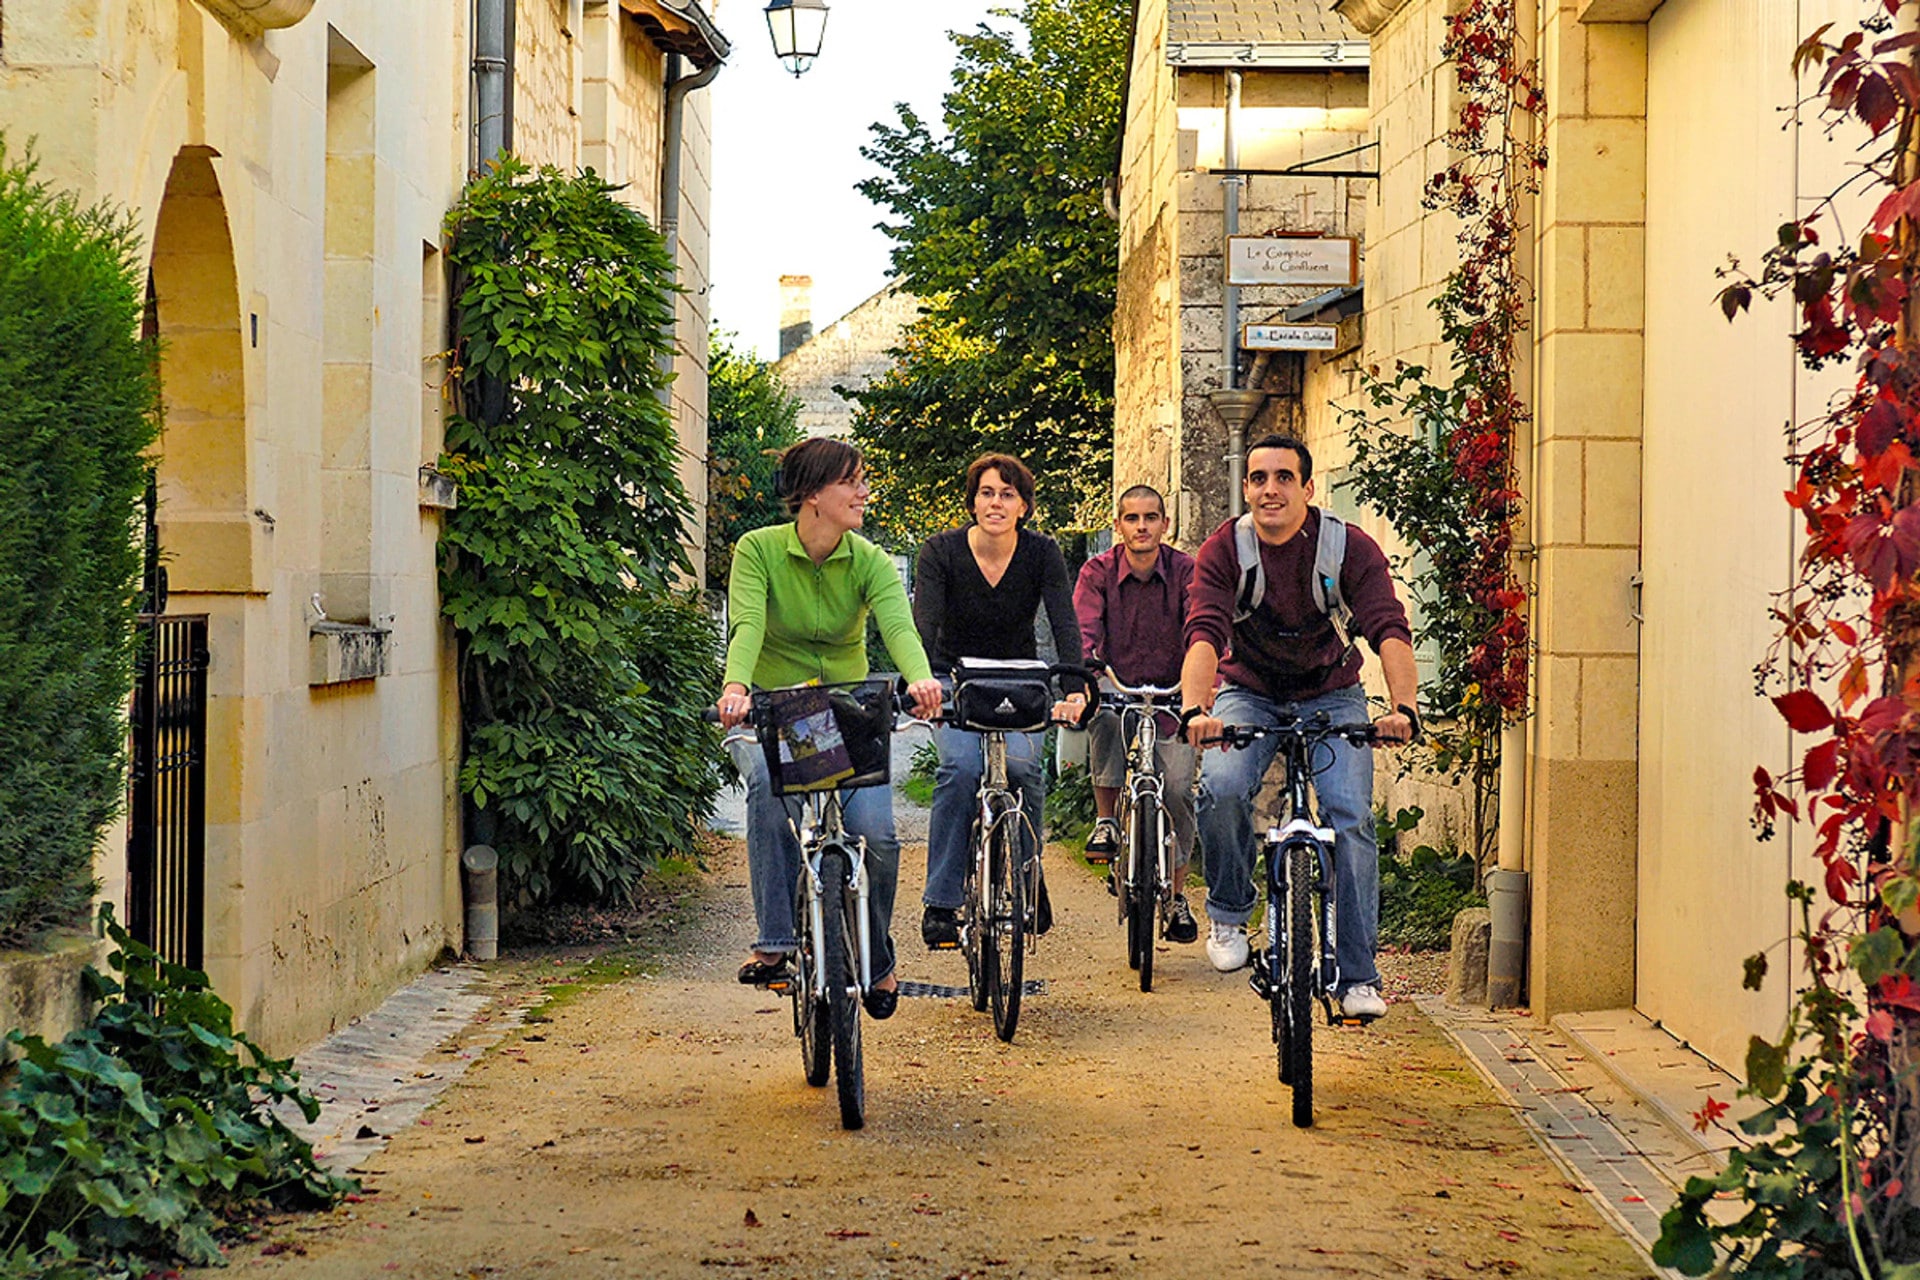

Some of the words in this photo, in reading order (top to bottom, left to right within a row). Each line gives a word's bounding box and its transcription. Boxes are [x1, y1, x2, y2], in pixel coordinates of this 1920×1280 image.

[1247, 247, 1261, 259] Le
[1266, 247, 1313, 261] Comptoir
[1262, 261, 1275, 272] du
[1280, 260, 1329, 272] Confluent
